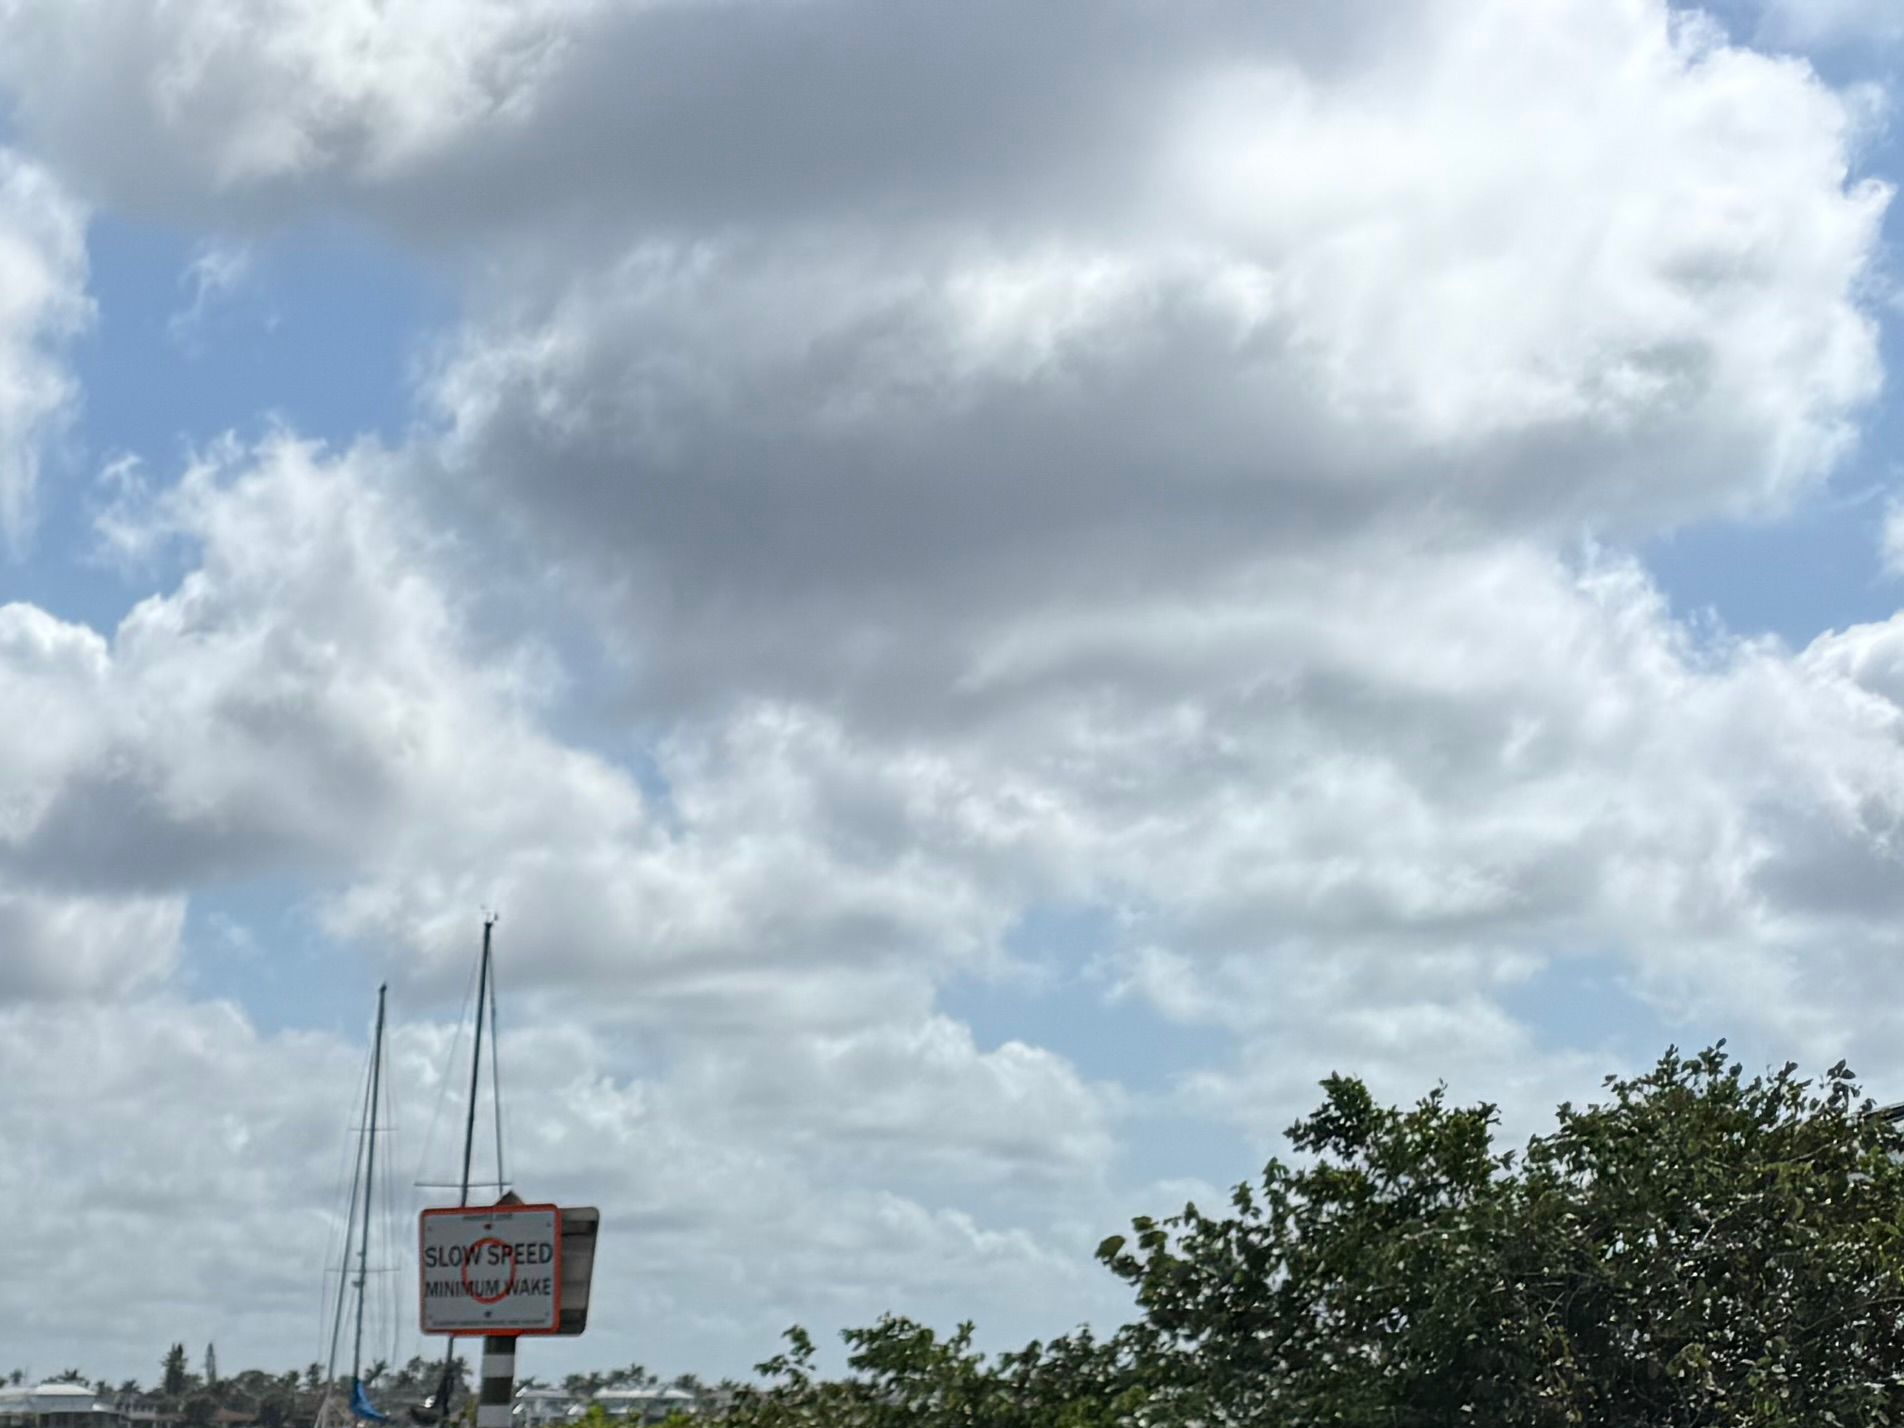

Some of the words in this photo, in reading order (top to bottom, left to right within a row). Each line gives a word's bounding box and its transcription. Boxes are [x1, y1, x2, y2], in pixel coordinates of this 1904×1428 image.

[425, 1245, 482, 1268] SLOW
[487, 1242, 554, 1266] SPEED
[425, 1279, 500, 1298] MINIMUM
[505, 1277, 551, 1296] WAKE
